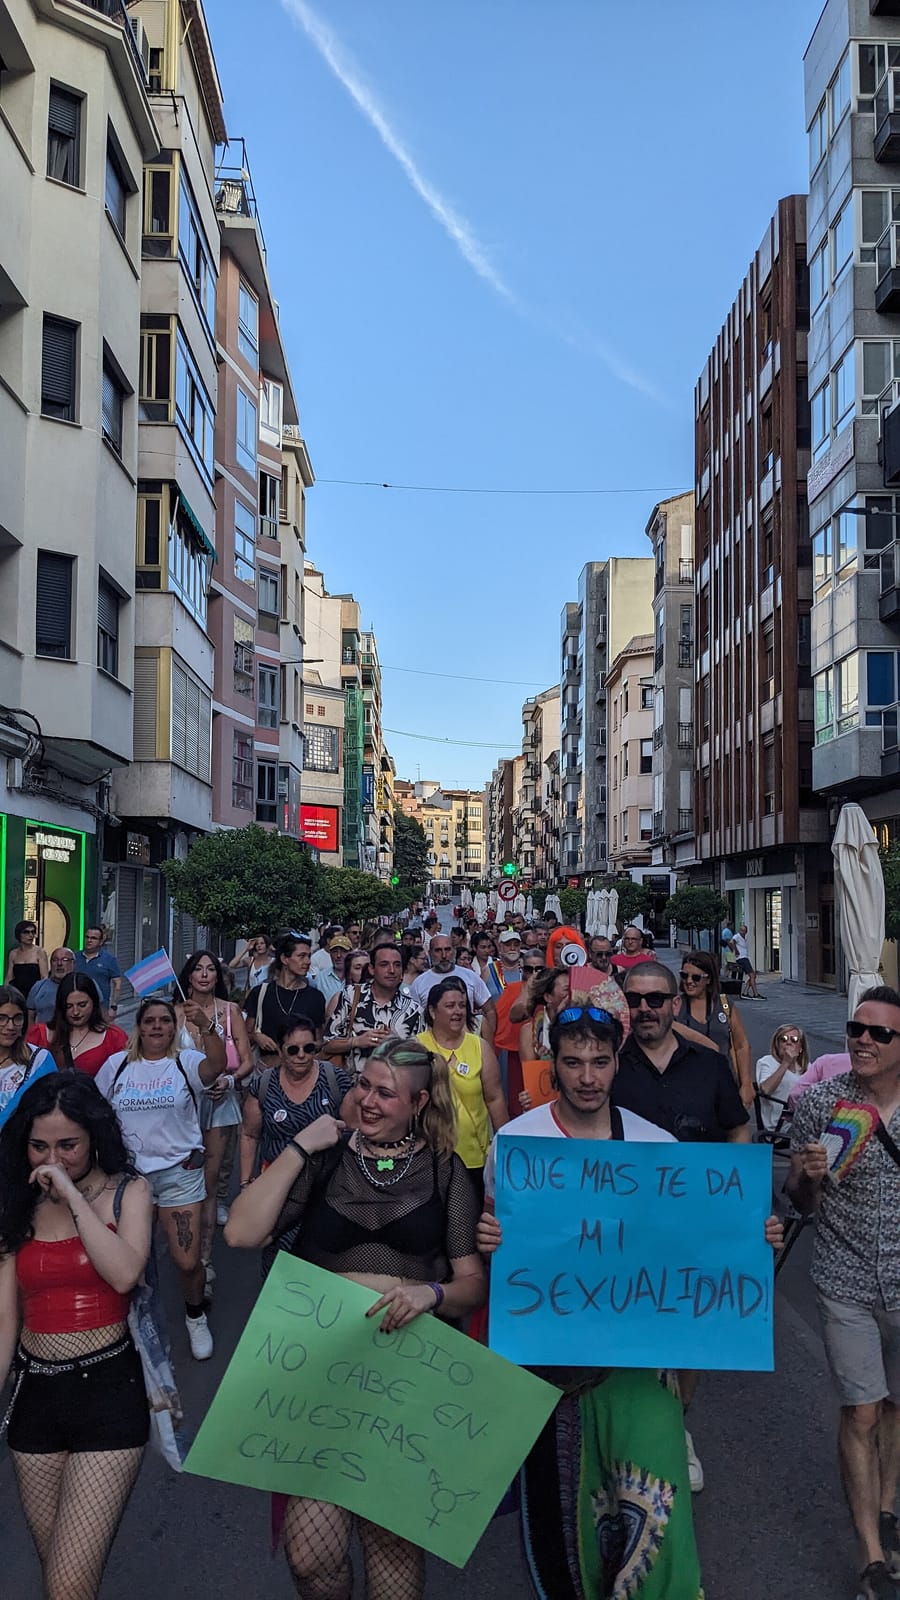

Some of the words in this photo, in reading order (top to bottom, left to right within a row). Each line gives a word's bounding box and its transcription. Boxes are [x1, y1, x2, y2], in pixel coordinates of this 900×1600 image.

[119, 1096, 175, 1107] FORMANDO
[500, 1144, 565, 1192] ¡QUE
[580, 1157, 640, 1196] MAS
[656, 1165, 687, 1198] TE
[706, 1166, 744, 1200] DA
[506, 1265, 769, 1322] SEXUALIDAD!
[276, 1280, 343, 1329] SU
[372, 1325, 474, 1387] ODIO
[255, 1332, 307, 1372] NO
[326, 1360, 416, 1403] CABE
[253, 1388, 428, 1463] NUESTRAS
[239, 1432, 367, 1482] CALLES
